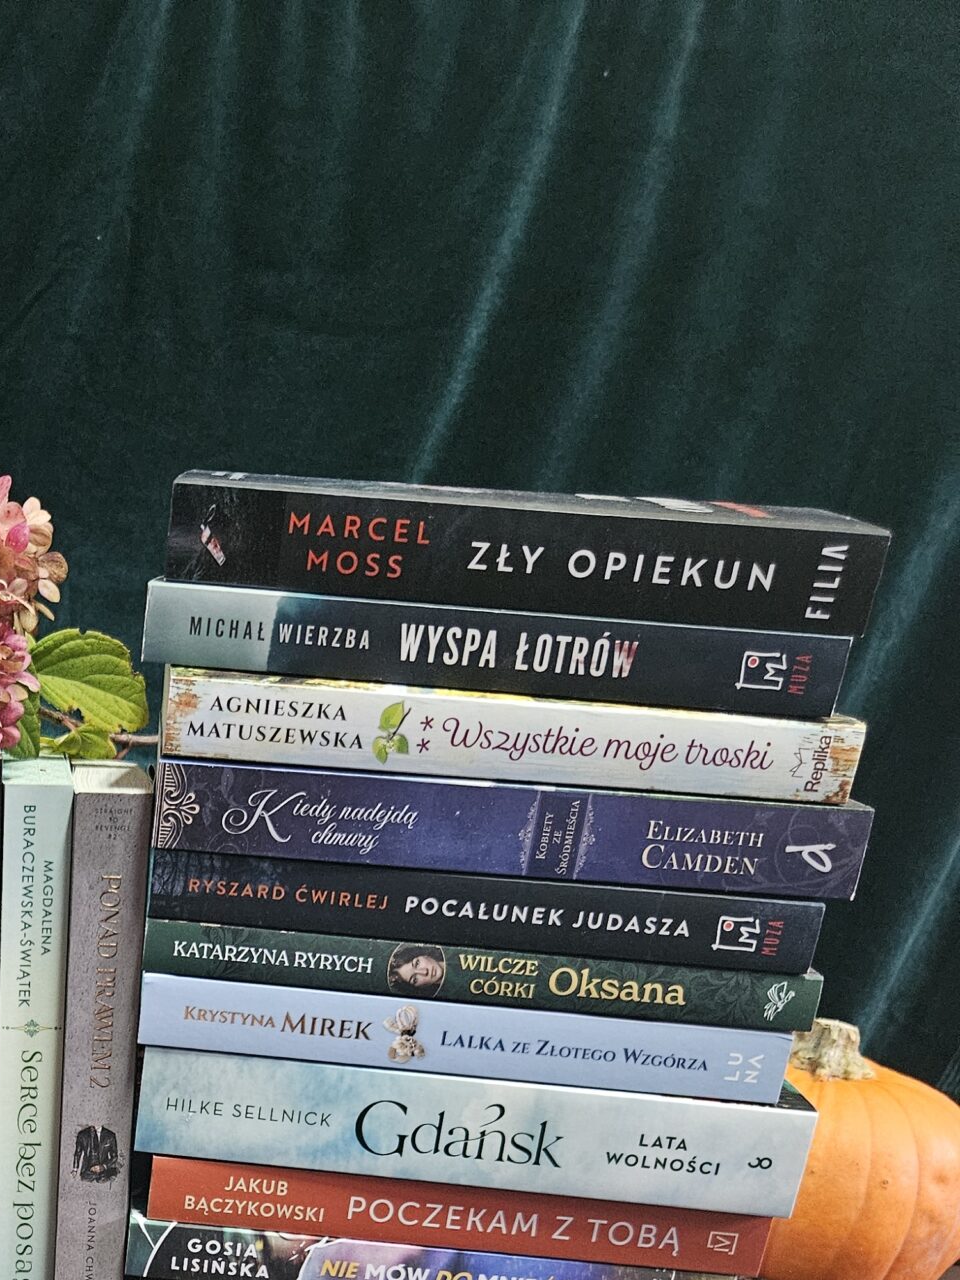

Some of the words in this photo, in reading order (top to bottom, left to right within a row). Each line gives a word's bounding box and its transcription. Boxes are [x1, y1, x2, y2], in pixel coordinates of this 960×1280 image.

[287, 510, 431, 546] MARCEL
[306, 549, 404, 580] MOSS
[467, 540, 544, 575] ZŁY
[567, 549, 776, 593] OPIEKUN
[804, 544, 849, 621] FILIA
[189, 616, 266, 642] MICHAŁ
[278, 623, 371, 651] WIERZBA
[399, 622, 498, 669] WYSPA
[514, 631, 639, 679] ŁOTRÓW
[787, 653, 813, 695] MUZA
[210, 696, 348, 722] AGNIESZKA
[187, 720, 364, 750] MATUSZEWSKA
[442, 717, 598, 762] Wszystkie
[603, 733, 679, 771] moje
[685, 738, 774, 771] troski
[803, 734, 833, 793] Replika
[221, 789, 336, 843] Kiedy
[338, 800, 420, 830] nadejdą
[311, 823, 380, 855] chmury
[535, 811, 555, 861] KOBIETY
[552, 830, 563, 844] ZE
[555, 799, 581, 876] ŚRÓDMIEŚCIA
[646, 820, 764, 848] ELIZABETH
[641, 843, 759, 877] CAMDEN
[16, 804, 37, 1008] BURACZEWSKA-ŚWIĄTEK
[40, 860, 55, 956] MAGDALENA
[188, 878, 286, 901] RYSZARD
[295, 883, 390, 910] ĆWIRLEJ
[96, 873, 123, 960] PONAD
[404, 896, 566, 927] POCAŁUNEK
[572, 910, 690, 938] JUDASZA
[761, 920, 785, 957] MUZA
[173, 940, 290, 967] KATARZYNA
[294, 952, 373, 974] RYRYCH
[458, 954, 539, 976] WILCZE
[470, 976, 536, 999] CÓRKI
[547, 966, 688, 1006] Oksana
[91, 967, 117, 1073] PRAWEM
[183, 1005, 276, 1029] KRYSTYNA
[280, 1011, 374, 1041] MIREK
[441, 1030, 506, 1053] LALKA
[89, 1076, 111, 1089] 2
[165, 1096, 224, 1117] HILKE
[232, 1103, 332, 1128] SELLNICK
[354, 1100, 565, 1169] Gdańsk
[638, 1133, 688, 1152] LATA
[15, 1141, 42, 1193] bez
[605, 1151, 722, 1176] WOLNOŚCI
[224, 1175, 288, 1197] JAKUB
[184, 1194, 325, 1223] BĄCZYKOWSKI
[87, 1202, 97, 1251] JOANNA
[346, 1196, 538, 1238] POCZEKAM
[551, 1216, 574, 1242] Z
[587, 1218, 681, 1257] TOBĄ
[187, 1237, 258, 1258] GOSIA
[170, 1255, 270, 1279] LISIŃSKA
[320, 1259, 360, 1280] NIE
